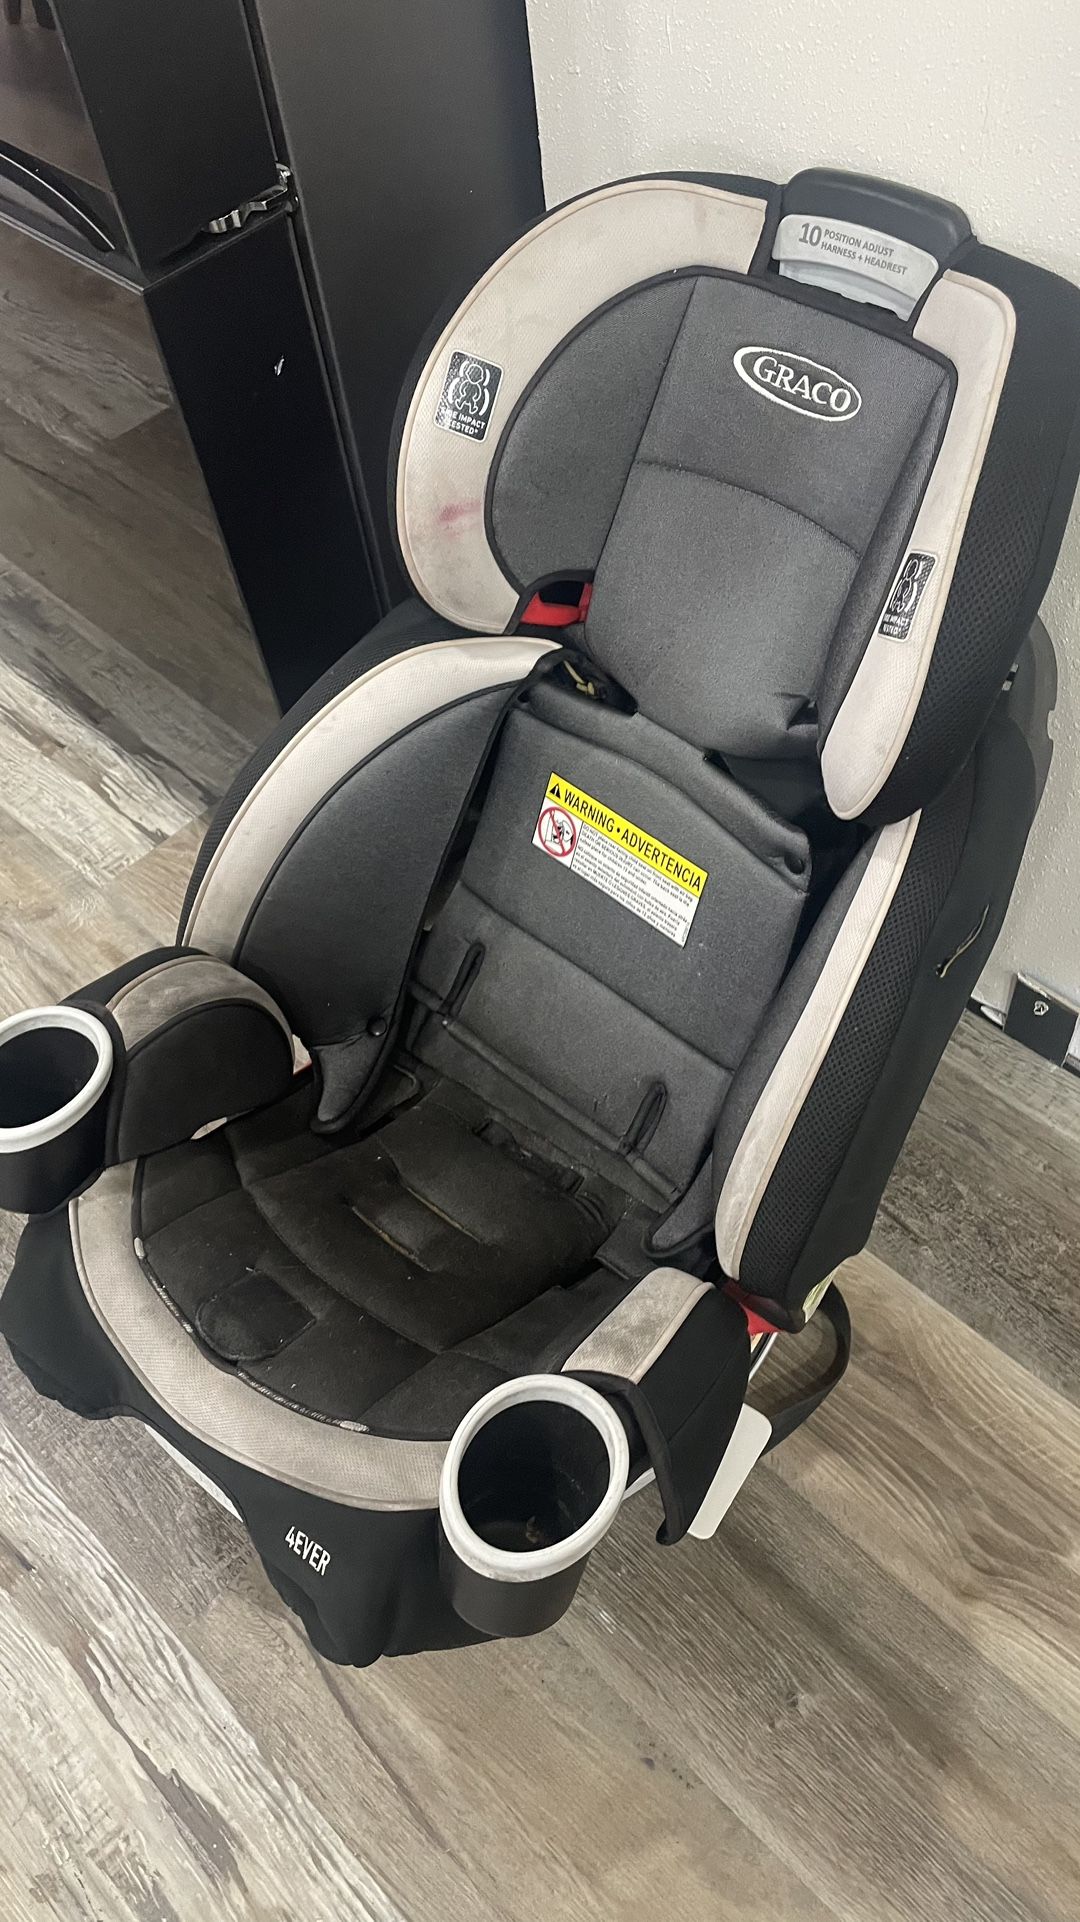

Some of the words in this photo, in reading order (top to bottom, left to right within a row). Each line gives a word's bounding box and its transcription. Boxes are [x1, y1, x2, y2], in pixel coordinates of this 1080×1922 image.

[799, 222, 823, 247] 10
[824, 229, 862, 248] POSITION
[863, 241, 895, 257] ADJUST
[821, 241, 857, 260] HARNESS
[864, 256, 908, 275] HEADREST
[753, 355, 852, 413] GRACO
[446, 419, 479, 434] ESTED
[458, 413, 486, 429] IMPACT
[564, 789, 615, 834] WARNING
[620, 828, 701, 892] ADVERTENCIA
[285, 1526, 331, 1576] 4EVER
